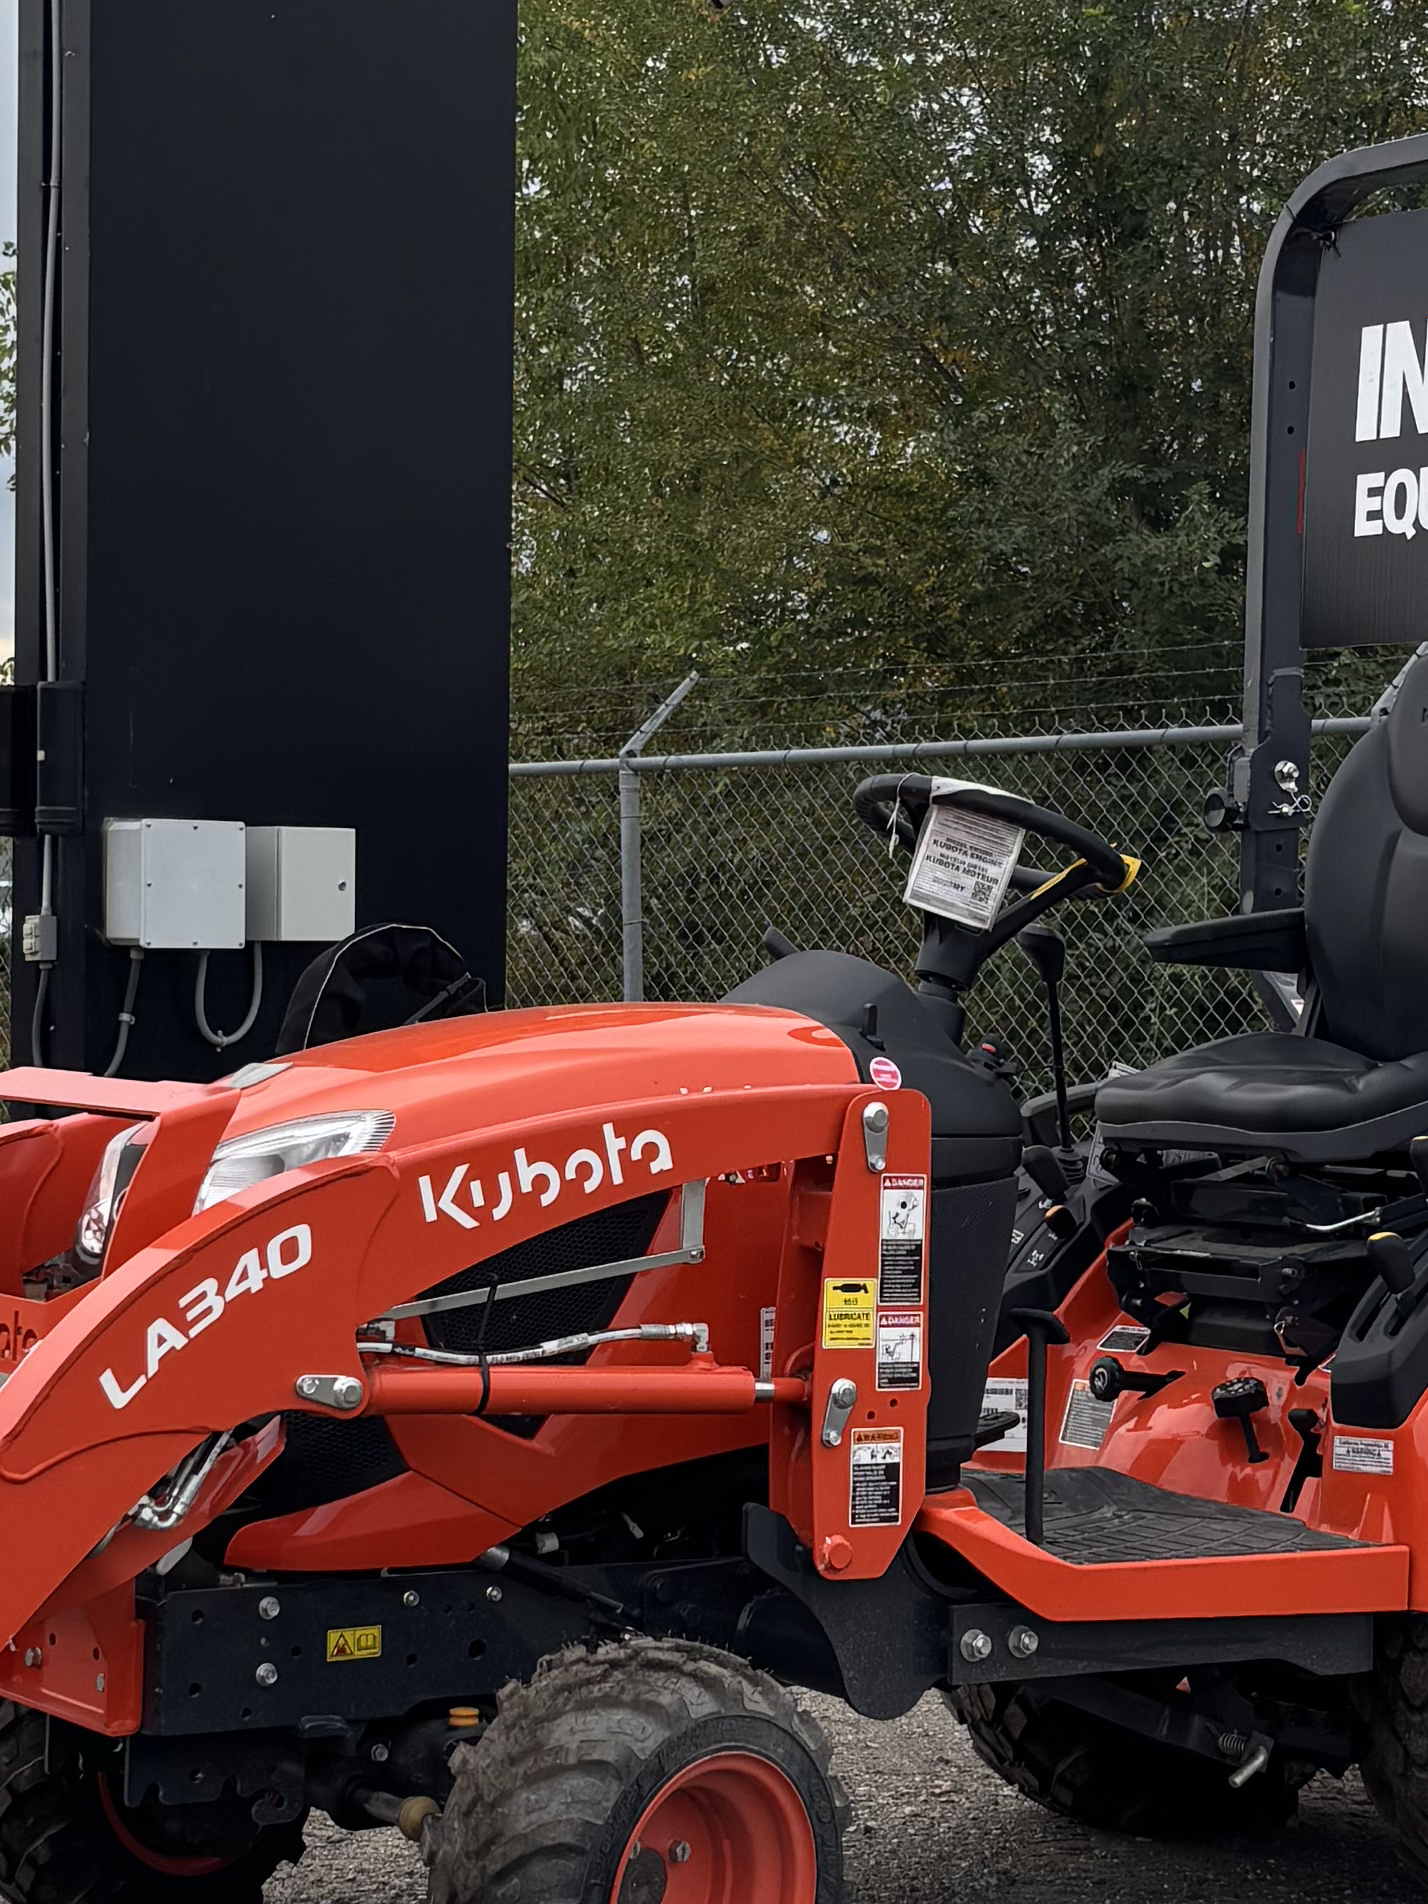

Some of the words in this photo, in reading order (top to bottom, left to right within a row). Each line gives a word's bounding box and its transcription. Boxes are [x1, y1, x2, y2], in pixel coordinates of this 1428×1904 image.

[933, 839, 968, 856] KUBOTA
[925, 854, 960, 872] KUBOTA
[418, 1122, 673, 1229] Kubota
[99, 1223, 312, 1409] LA340
[828, 1312, 871, 1321] LUBRICATE
